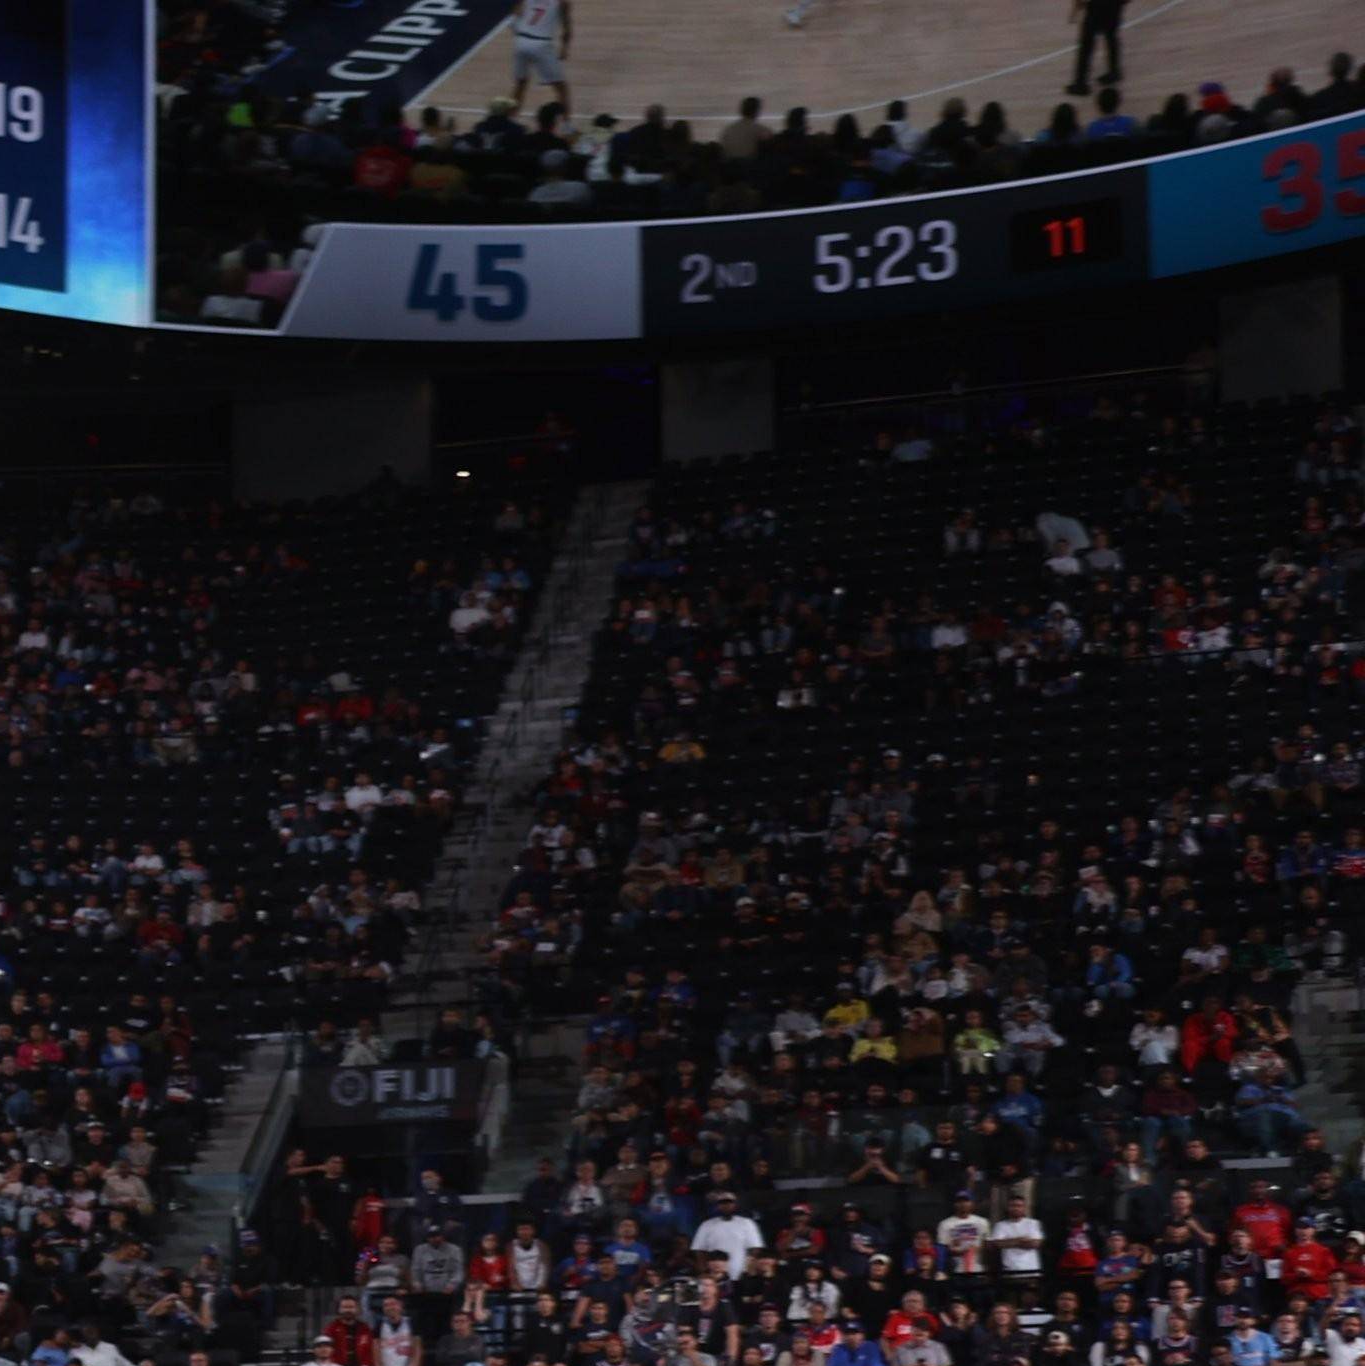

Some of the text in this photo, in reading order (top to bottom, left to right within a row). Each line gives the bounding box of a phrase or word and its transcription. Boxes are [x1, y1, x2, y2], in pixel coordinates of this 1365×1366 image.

[813, 219, 959, 293] 5:23
[1044, 216, 1087, 257] 11
[407, 243, 530, 324] 45
[680, 254, 758, 302] 2ND
[373, 1067, 455, 1102] FIJI
